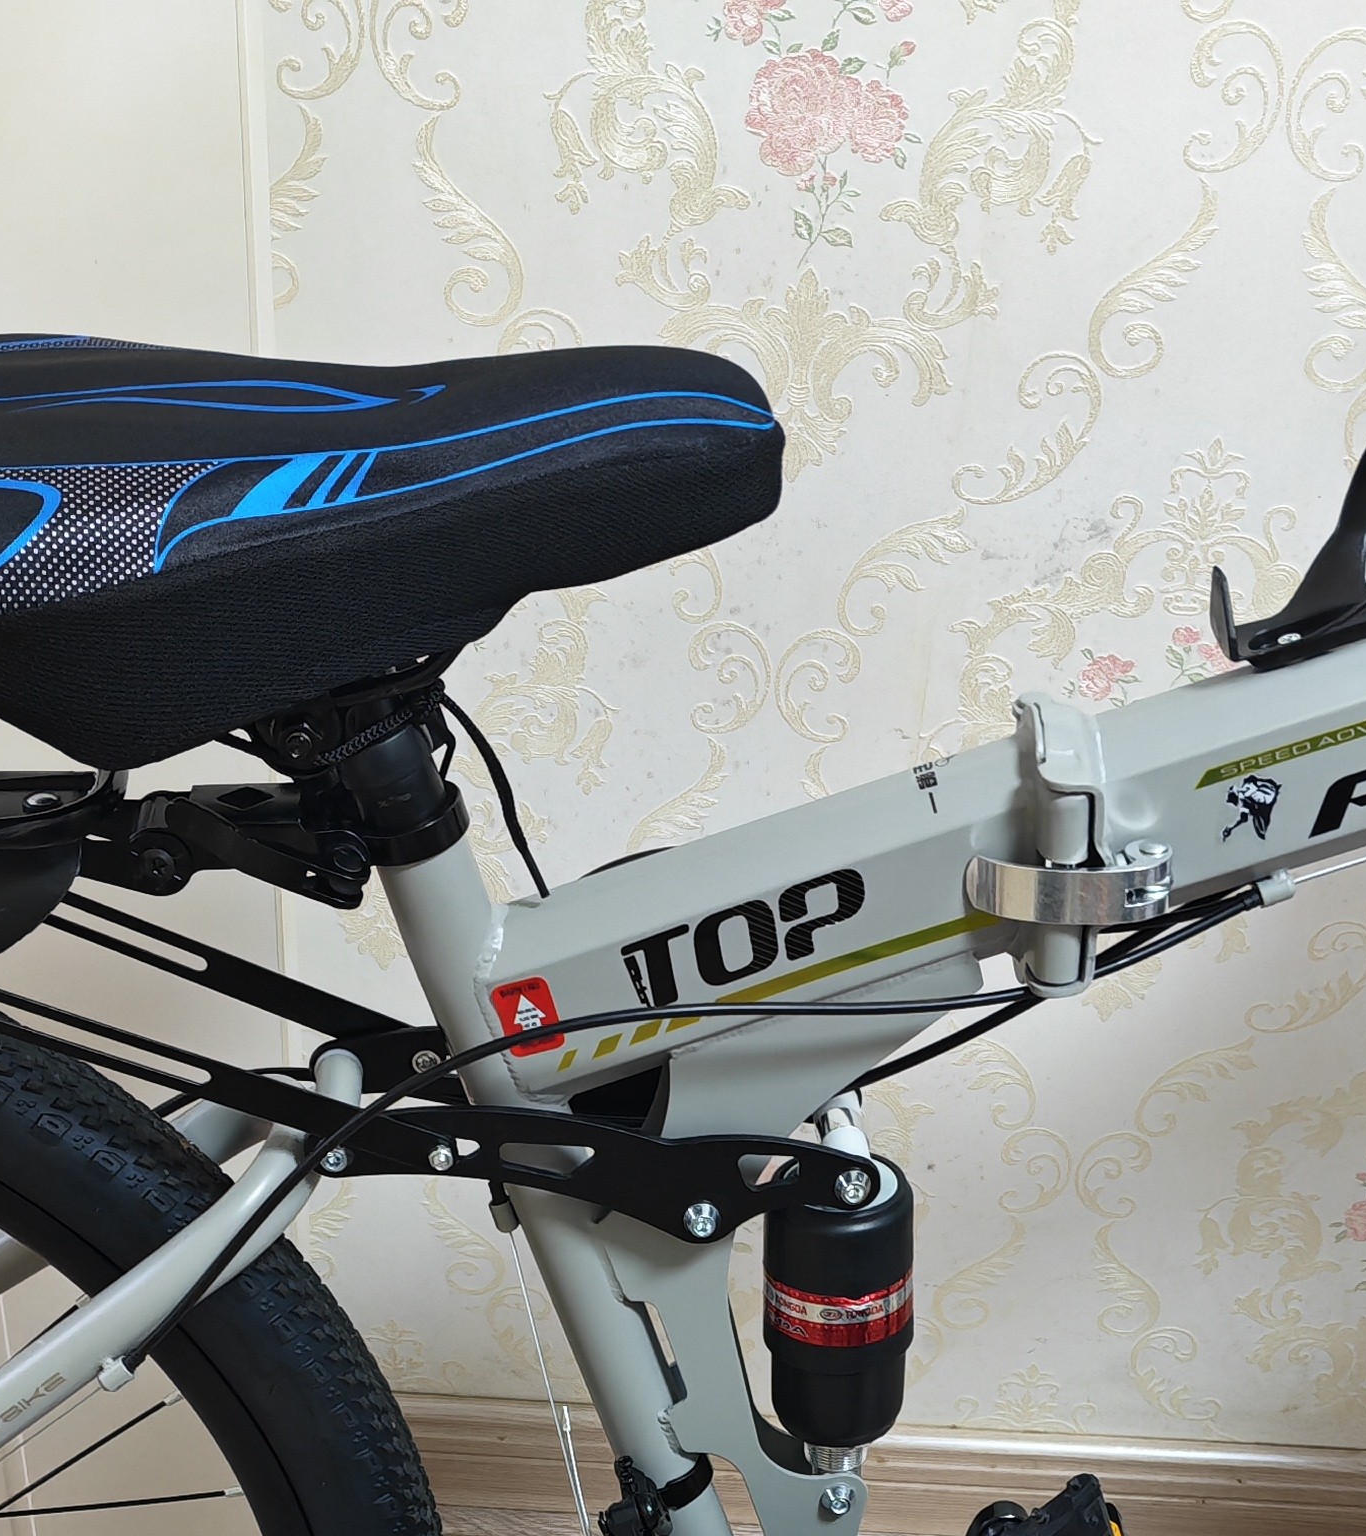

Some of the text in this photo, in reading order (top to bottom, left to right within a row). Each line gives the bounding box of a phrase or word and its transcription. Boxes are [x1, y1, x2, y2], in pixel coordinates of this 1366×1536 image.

[1219, 742, 1311, 778] SPEED
[620, 868, 866, 1008] TOP
[0, 1371, 67, 1423] BIKE
